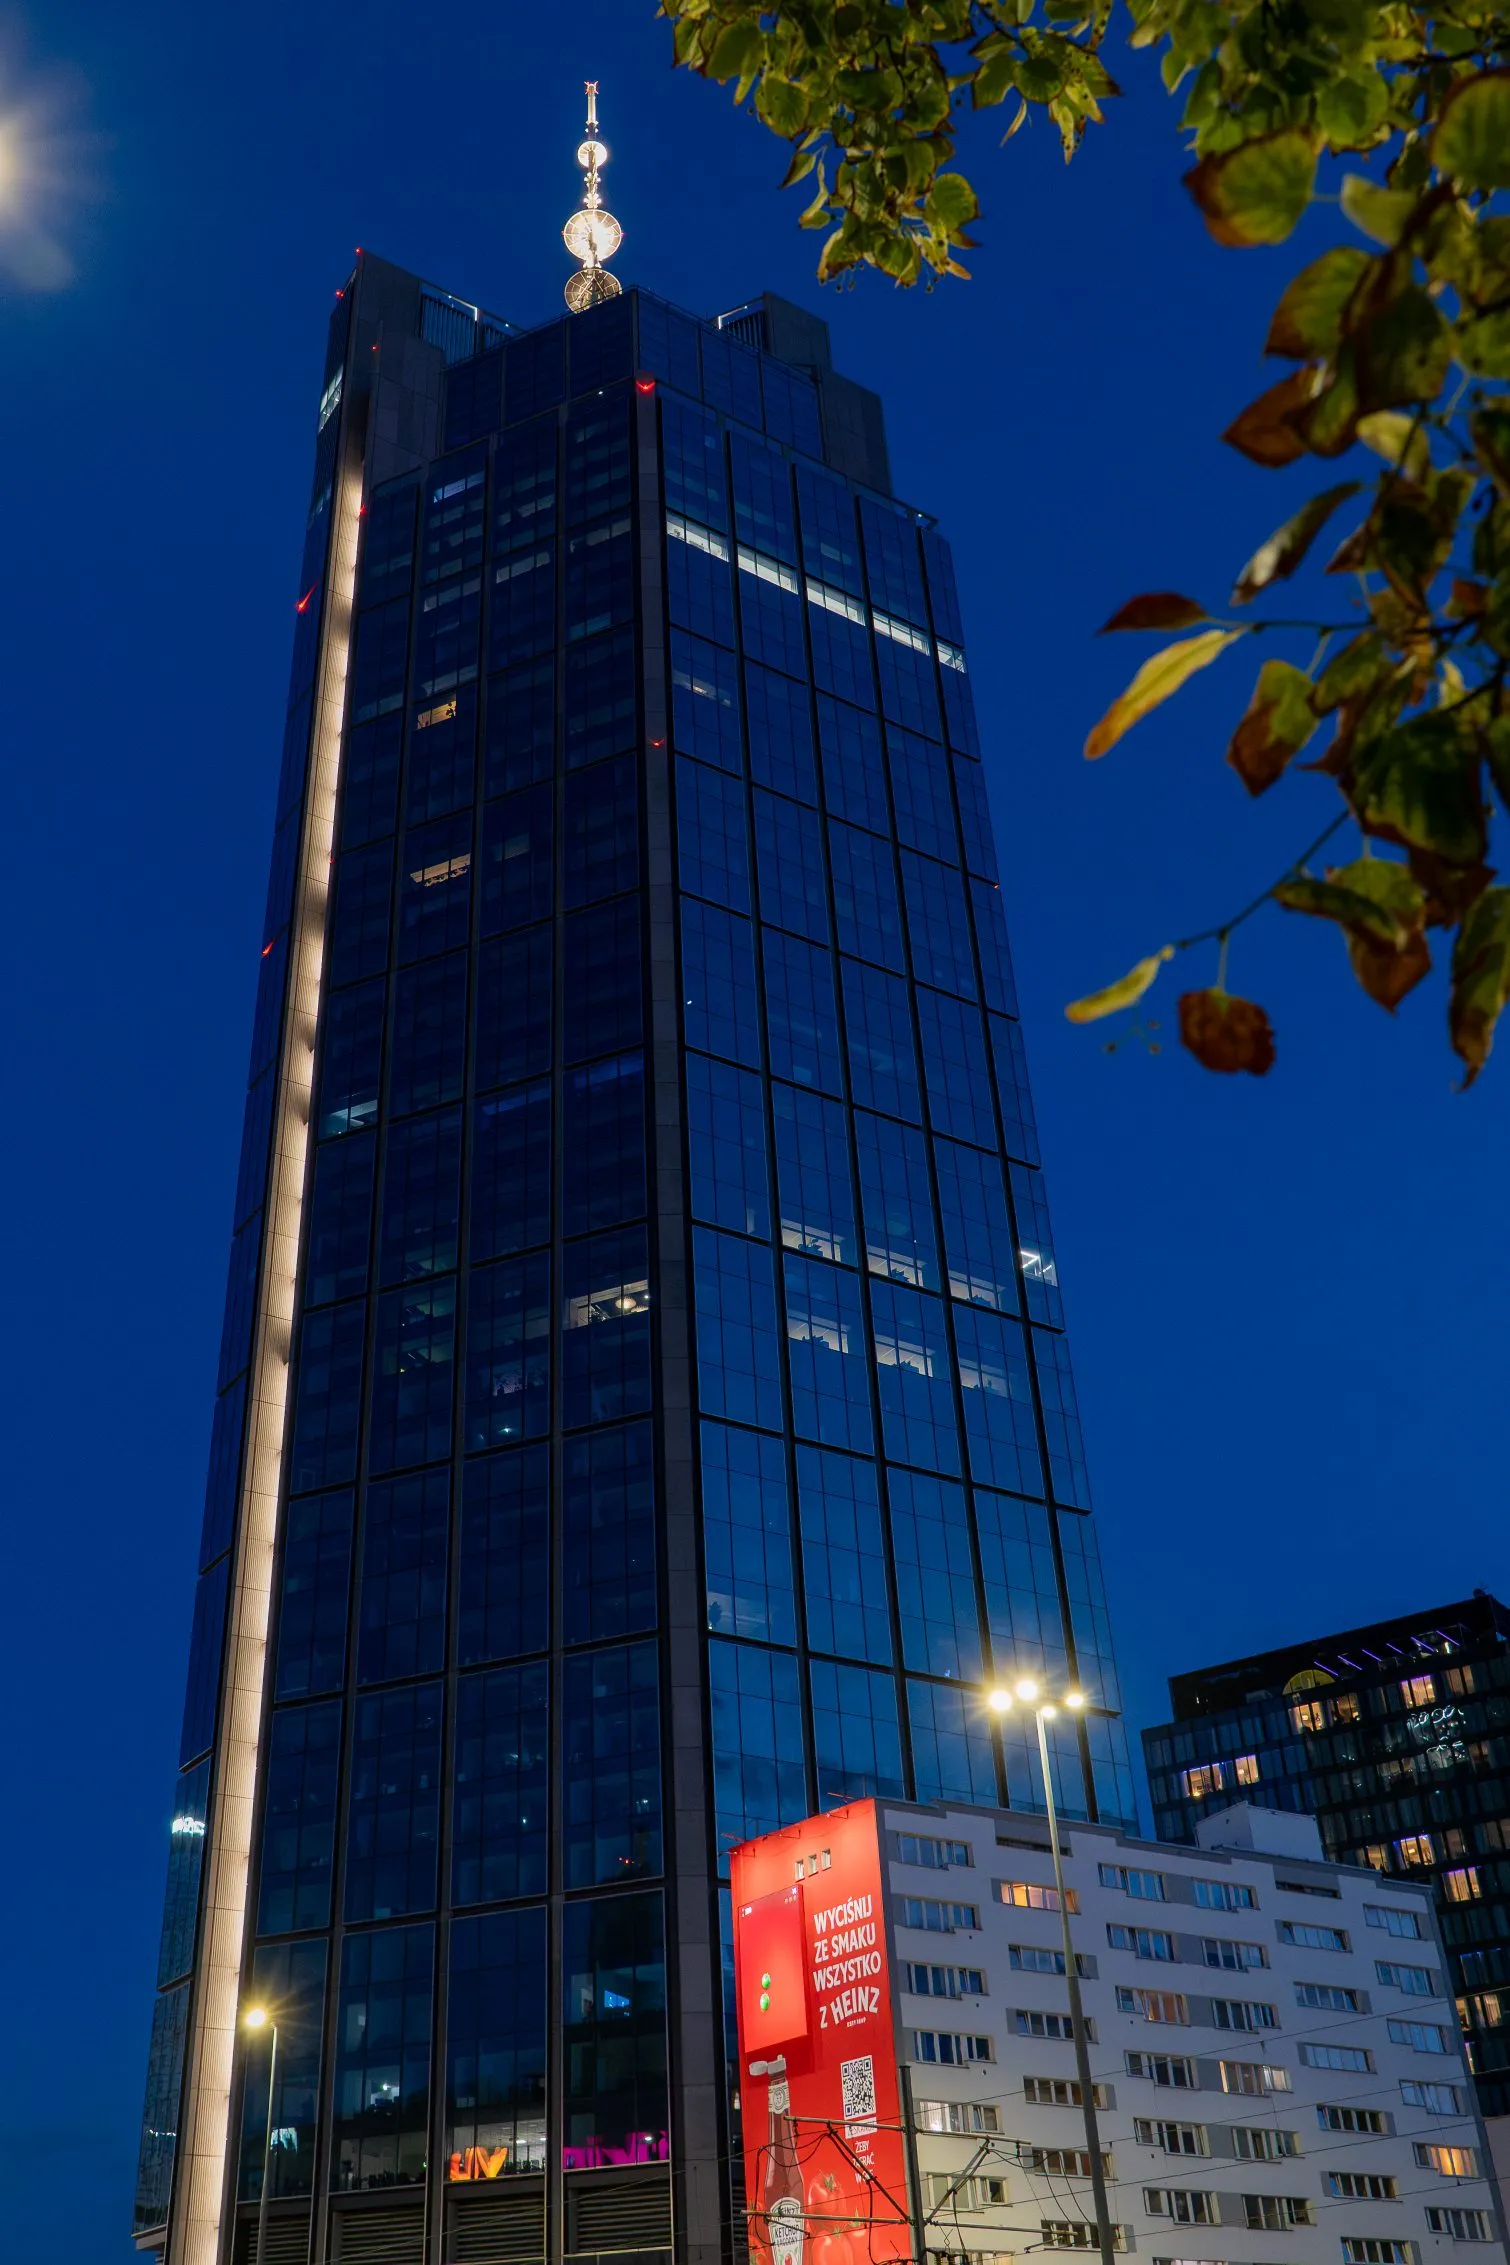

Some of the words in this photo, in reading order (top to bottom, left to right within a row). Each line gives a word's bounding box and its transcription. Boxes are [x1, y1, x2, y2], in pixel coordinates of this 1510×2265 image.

[814, 1894, 872, 1934] WYCIŚNIJ
[814, 1938, 829, 1963] ZE
[831, 1922, 876, 1958] SMAKU
[813, 1951, 881, 1992] WSZYSTKO
[819, 2005, 828, 2029] Z
[830, 1986, 880, 2025] HEINZ
